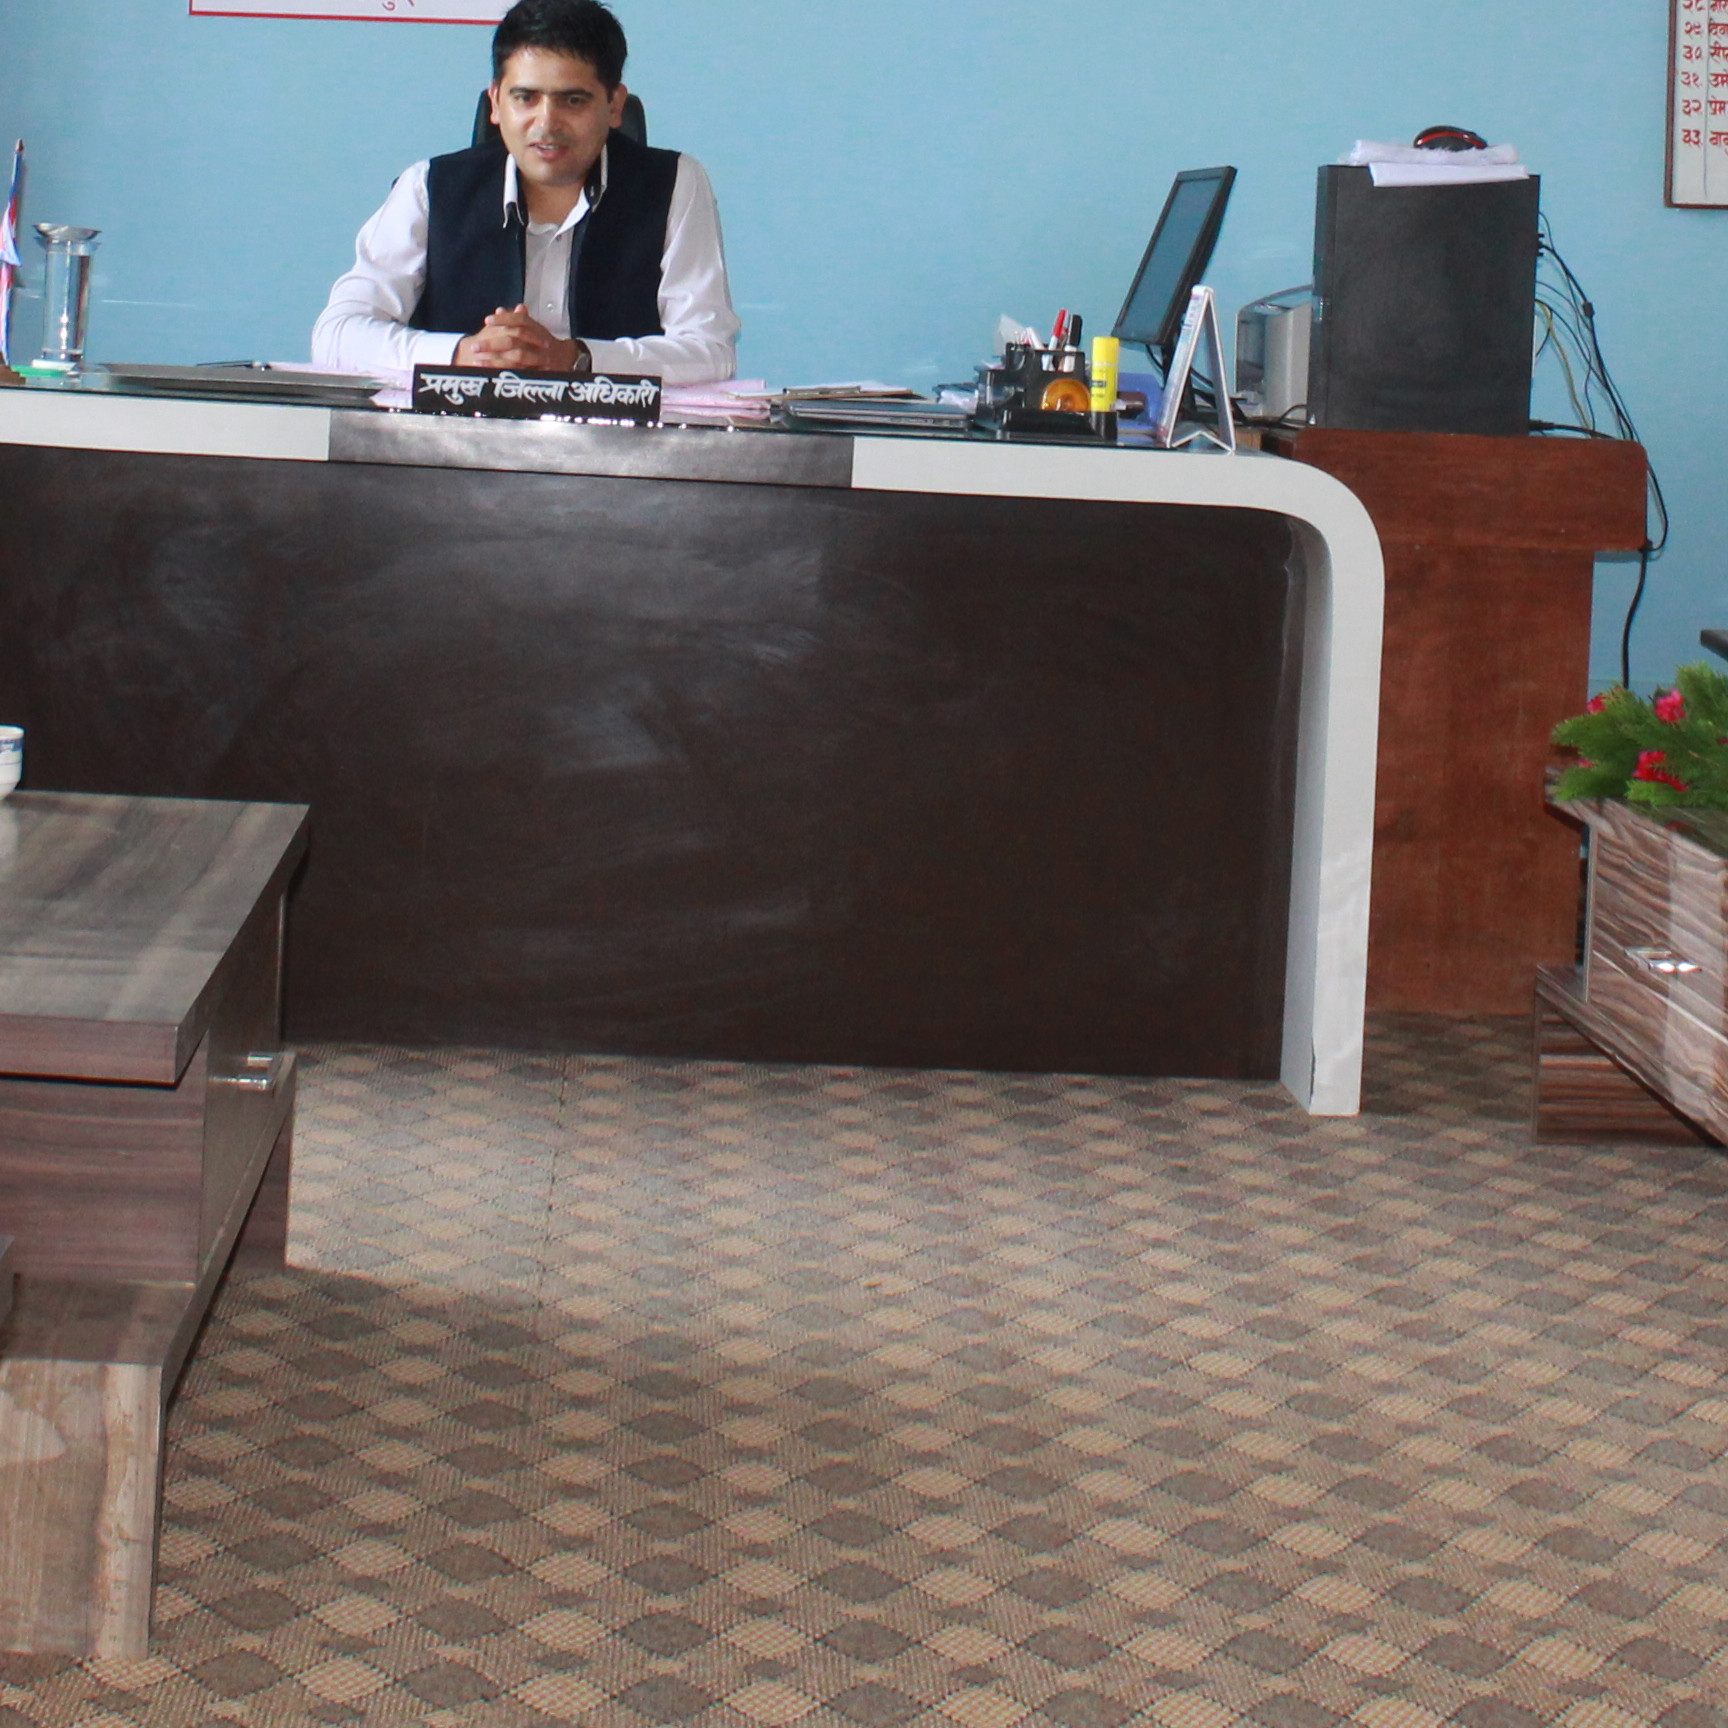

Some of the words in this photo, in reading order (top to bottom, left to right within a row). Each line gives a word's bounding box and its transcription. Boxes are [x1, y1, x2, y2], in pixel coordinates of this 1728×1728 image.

[418, 372, 489, 406] प्रमुख
[491, 371, 568, 403] जिल्ला
[569, 375, 659, 408] अधिकारी
